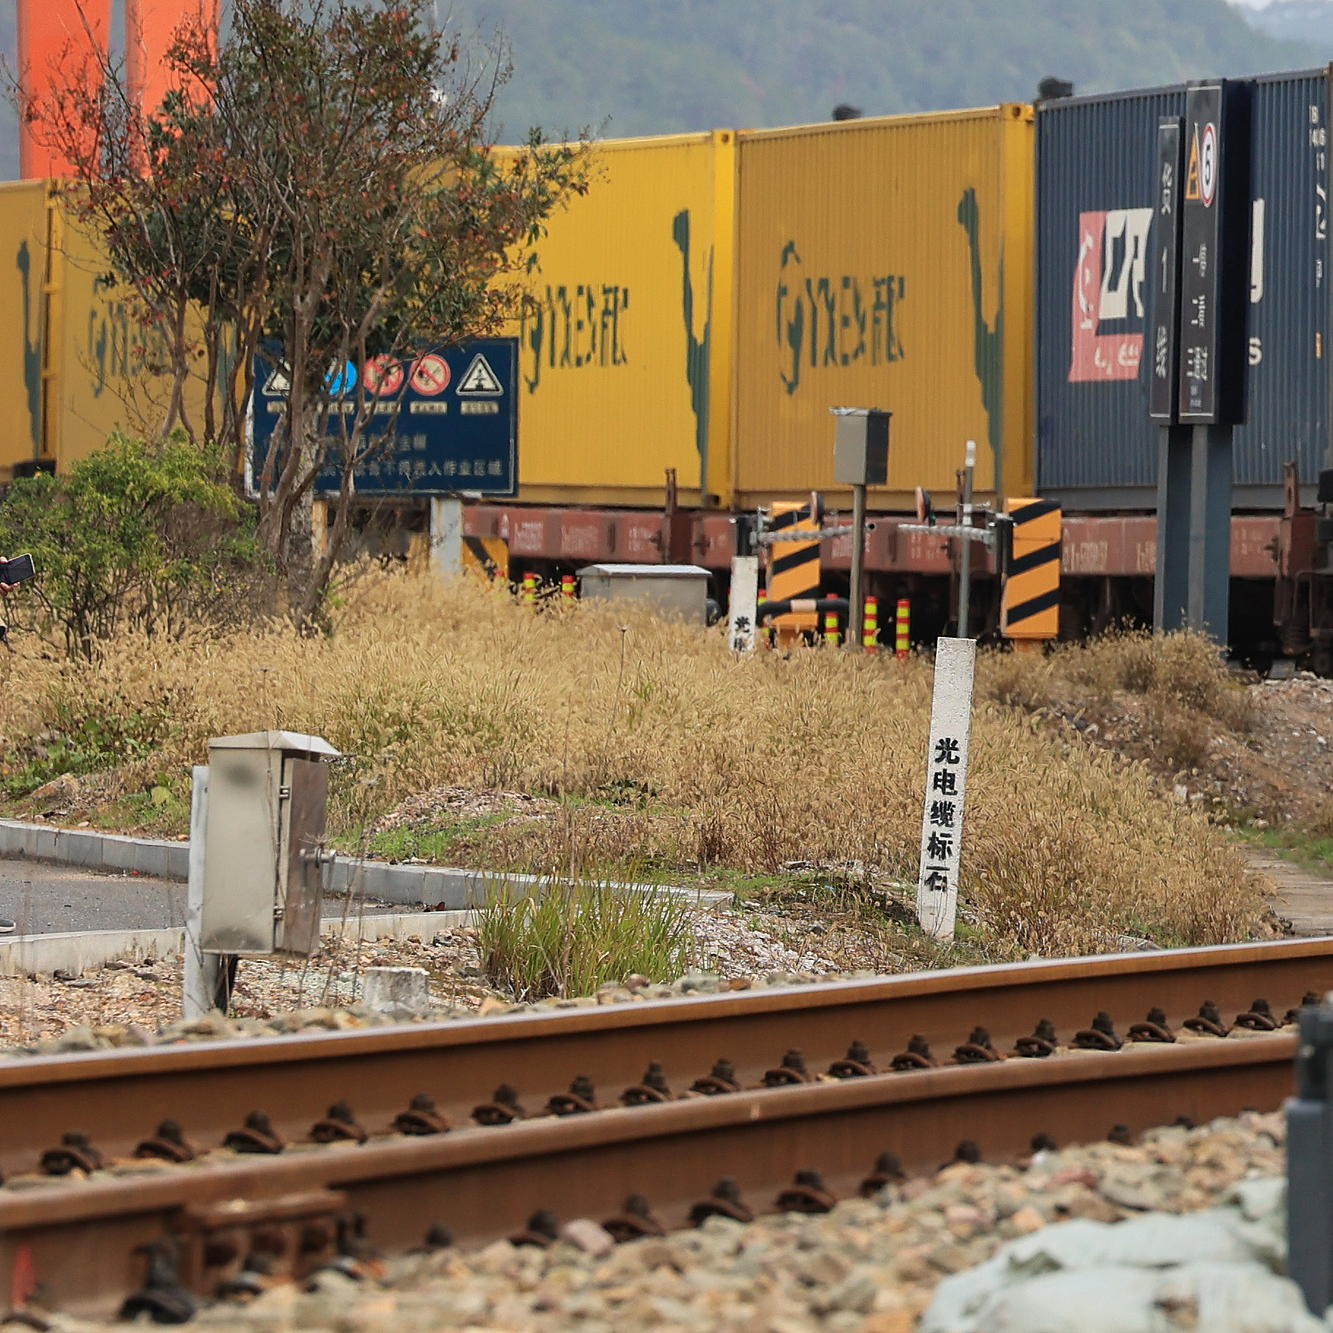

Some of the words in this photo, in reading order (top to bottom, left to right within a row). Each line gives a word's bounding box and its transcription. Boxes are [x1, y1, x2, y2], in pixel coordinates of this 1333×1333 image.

[923, 736, 961, 893] 光电缆标石
